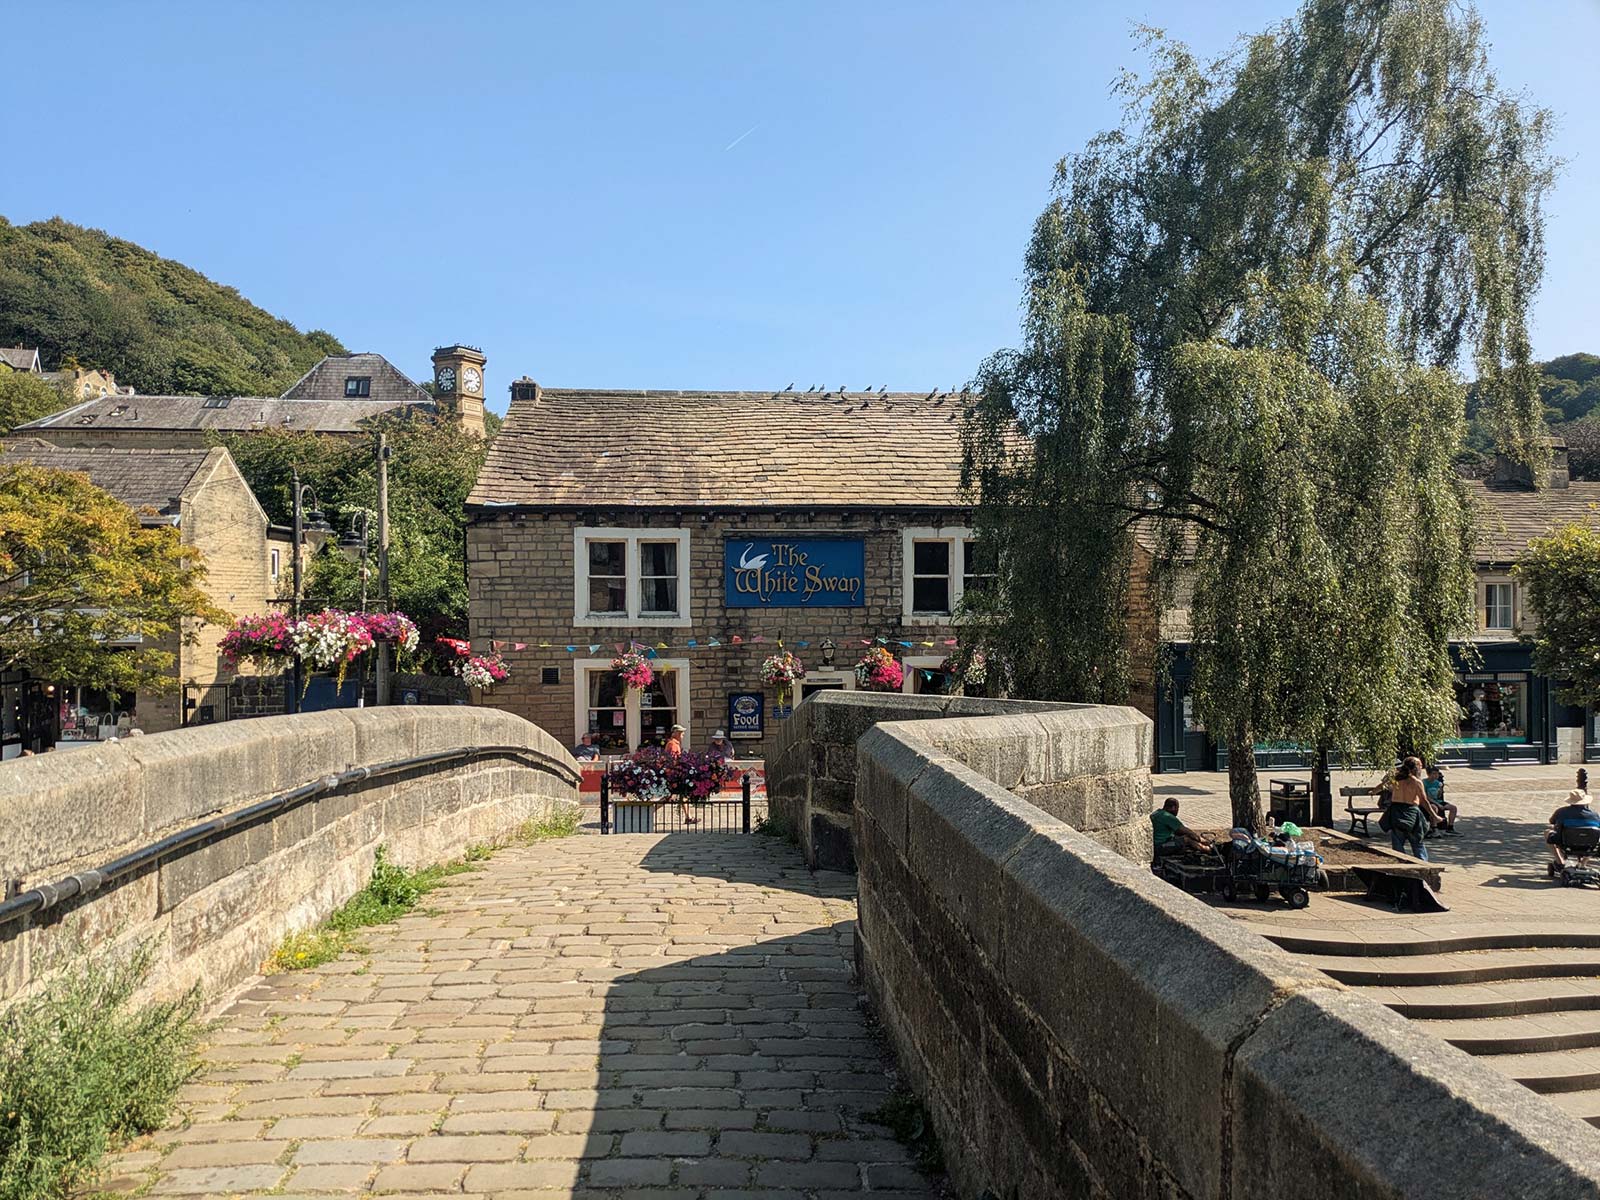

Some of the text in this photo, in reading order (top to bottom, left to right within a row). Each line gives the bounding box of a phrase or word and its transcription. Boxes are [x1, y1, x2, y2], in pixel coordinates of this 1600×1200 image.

[771, 544, 809, 574] The
[731, 564, 861, 602] White Swan
[733, 713, 759, 725] Food
